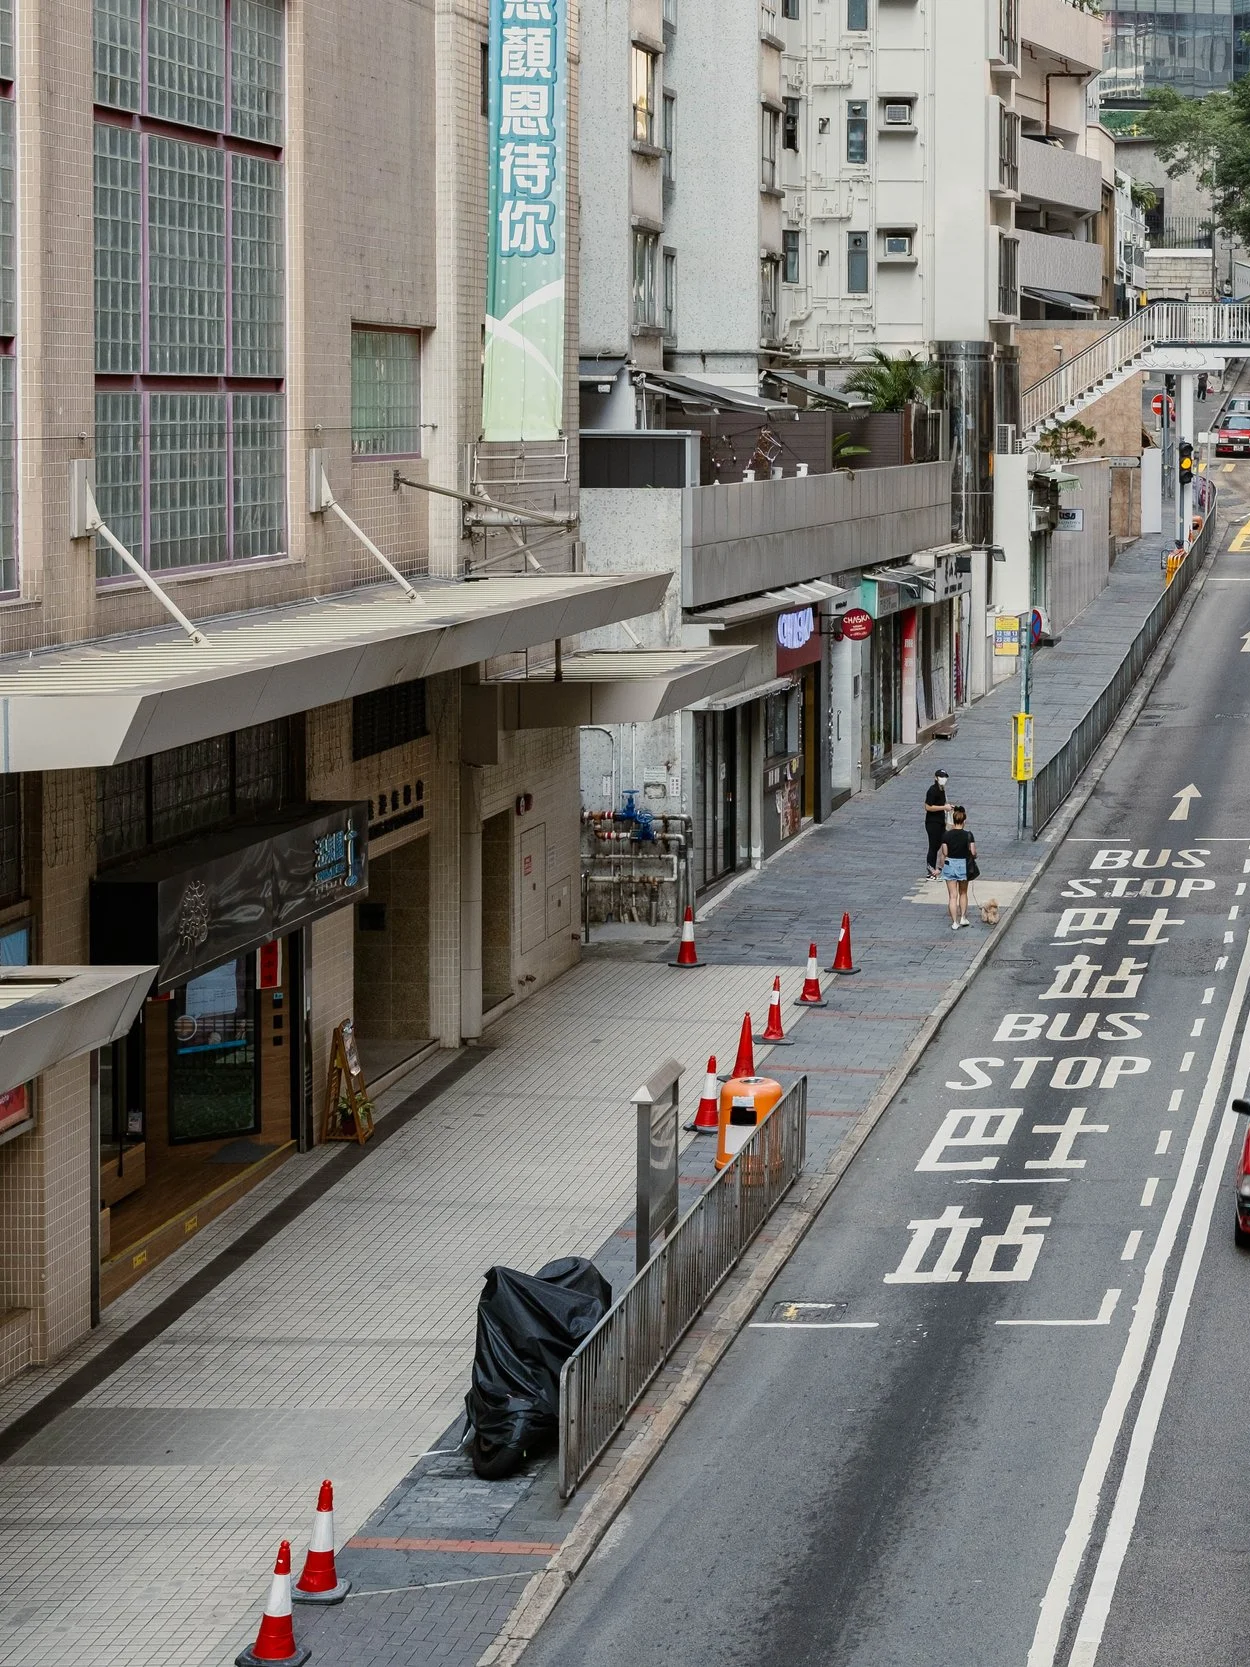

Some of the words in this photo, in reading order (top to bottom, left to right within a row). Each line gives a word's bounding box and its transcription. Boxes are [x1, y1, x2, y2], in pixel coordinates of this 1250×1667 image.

[843, 614, 870, 624] CHASKA
[1089, 849, 1211, 870] BUS
[1061, 877, 1216, 899] STOP
[1049, 908, 1186, 946] 巴士
[1038, 954, 1149, 999] 站
[992, 1012, 1151, 1042] BUS
[945, 1056, 1151, 1090] STOP
[914, 1107, 1110, 1172] 巴士
[883, 1205, 1051, 1284] 站
